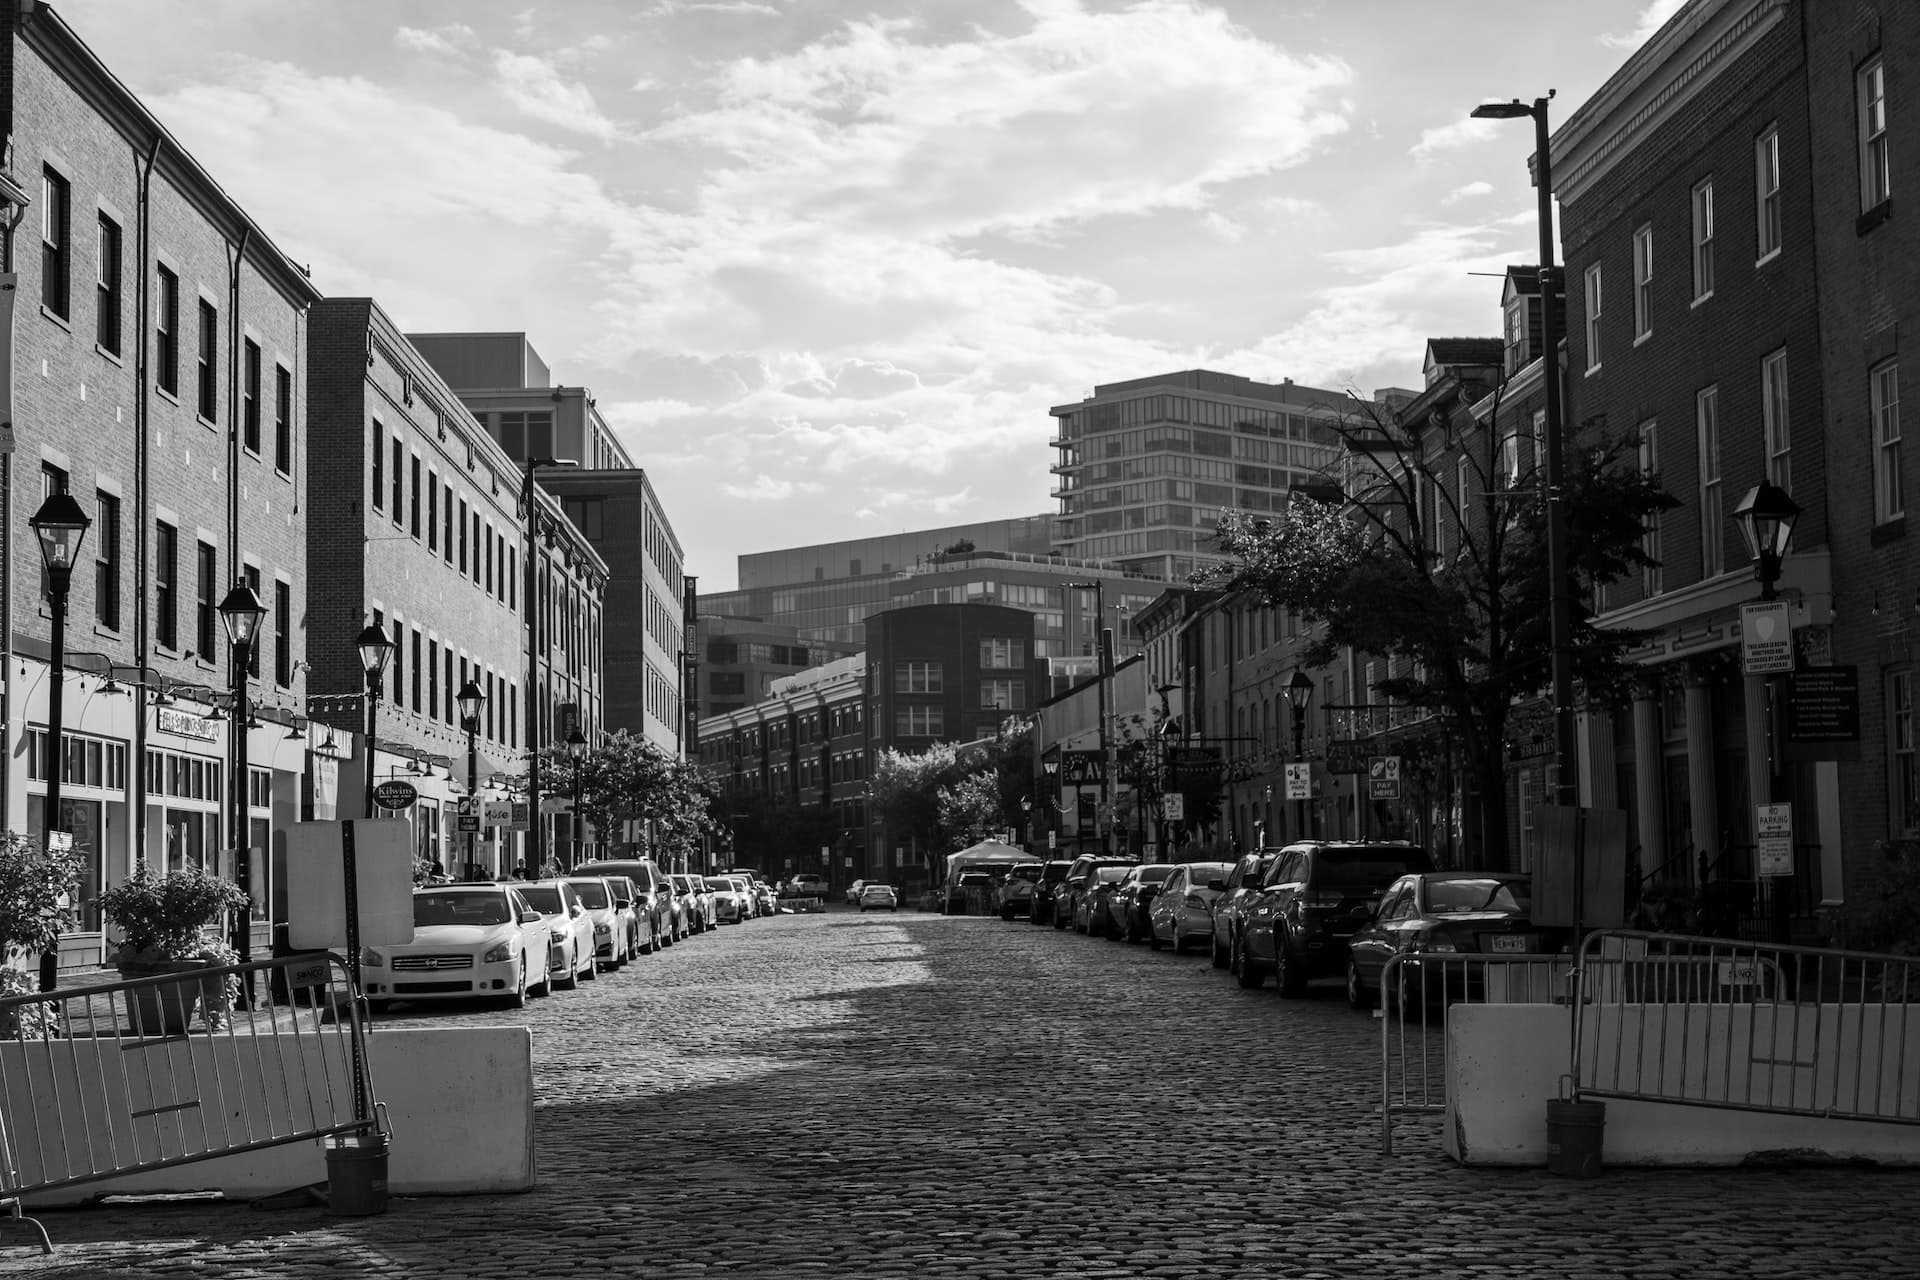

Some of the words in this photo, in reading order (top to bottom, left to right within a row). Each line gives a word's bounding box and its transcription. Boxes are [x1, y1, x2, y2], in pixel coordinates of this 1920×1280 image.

[378, 786, 413, 795] Kilwins
[1374, 789, 1395, 797] HERE
[1768, 807, 1778, 815] NO
[1759, 815, 1789, 825] PARKING
